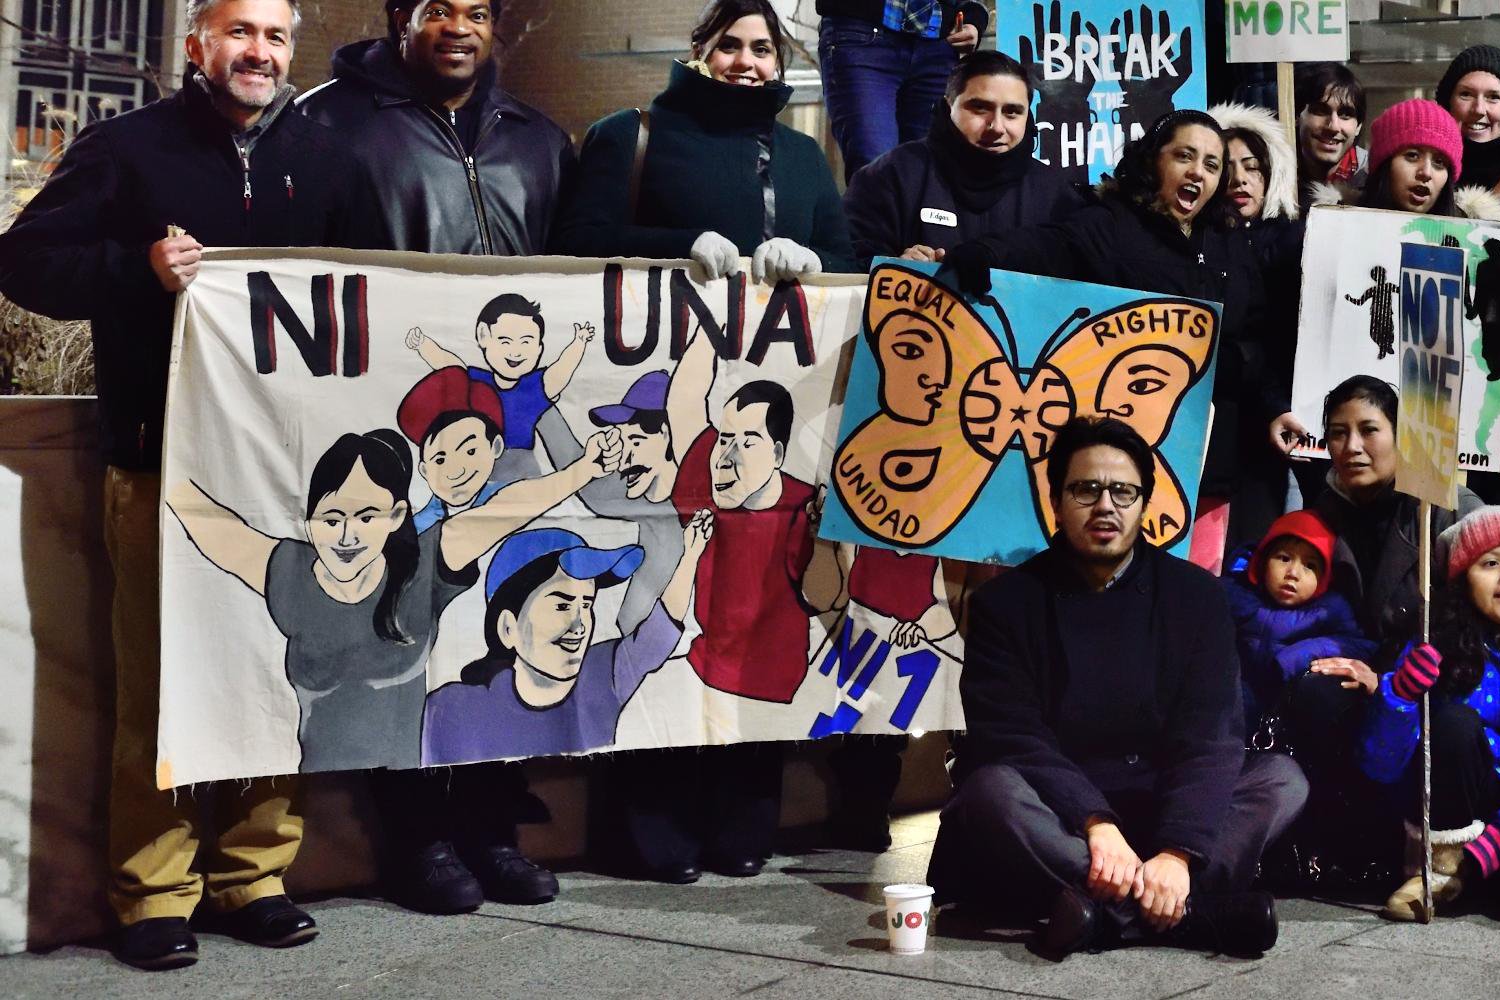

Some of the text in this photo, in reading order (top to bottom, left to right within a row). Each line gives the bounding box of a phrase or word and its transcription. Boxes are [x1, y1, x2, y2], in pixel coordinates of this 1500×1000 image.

[1234, 0, 1342, 35] MORE
[1043, 33, 1179, 82] BREAK
[1092, 91, 1128, 111] THE
[247, 263, 815, 377] NI UNA
[877, 277, 956, 330] EQUAL
[1091, 309, 1208, 347] RIGHTS
[1402, 271, 1460, 356] NOT
[1401, 347, 1460, 434] ONE
[839, 453, 920, 538] UNIDAD
[818, 615, 892, 701] NI
